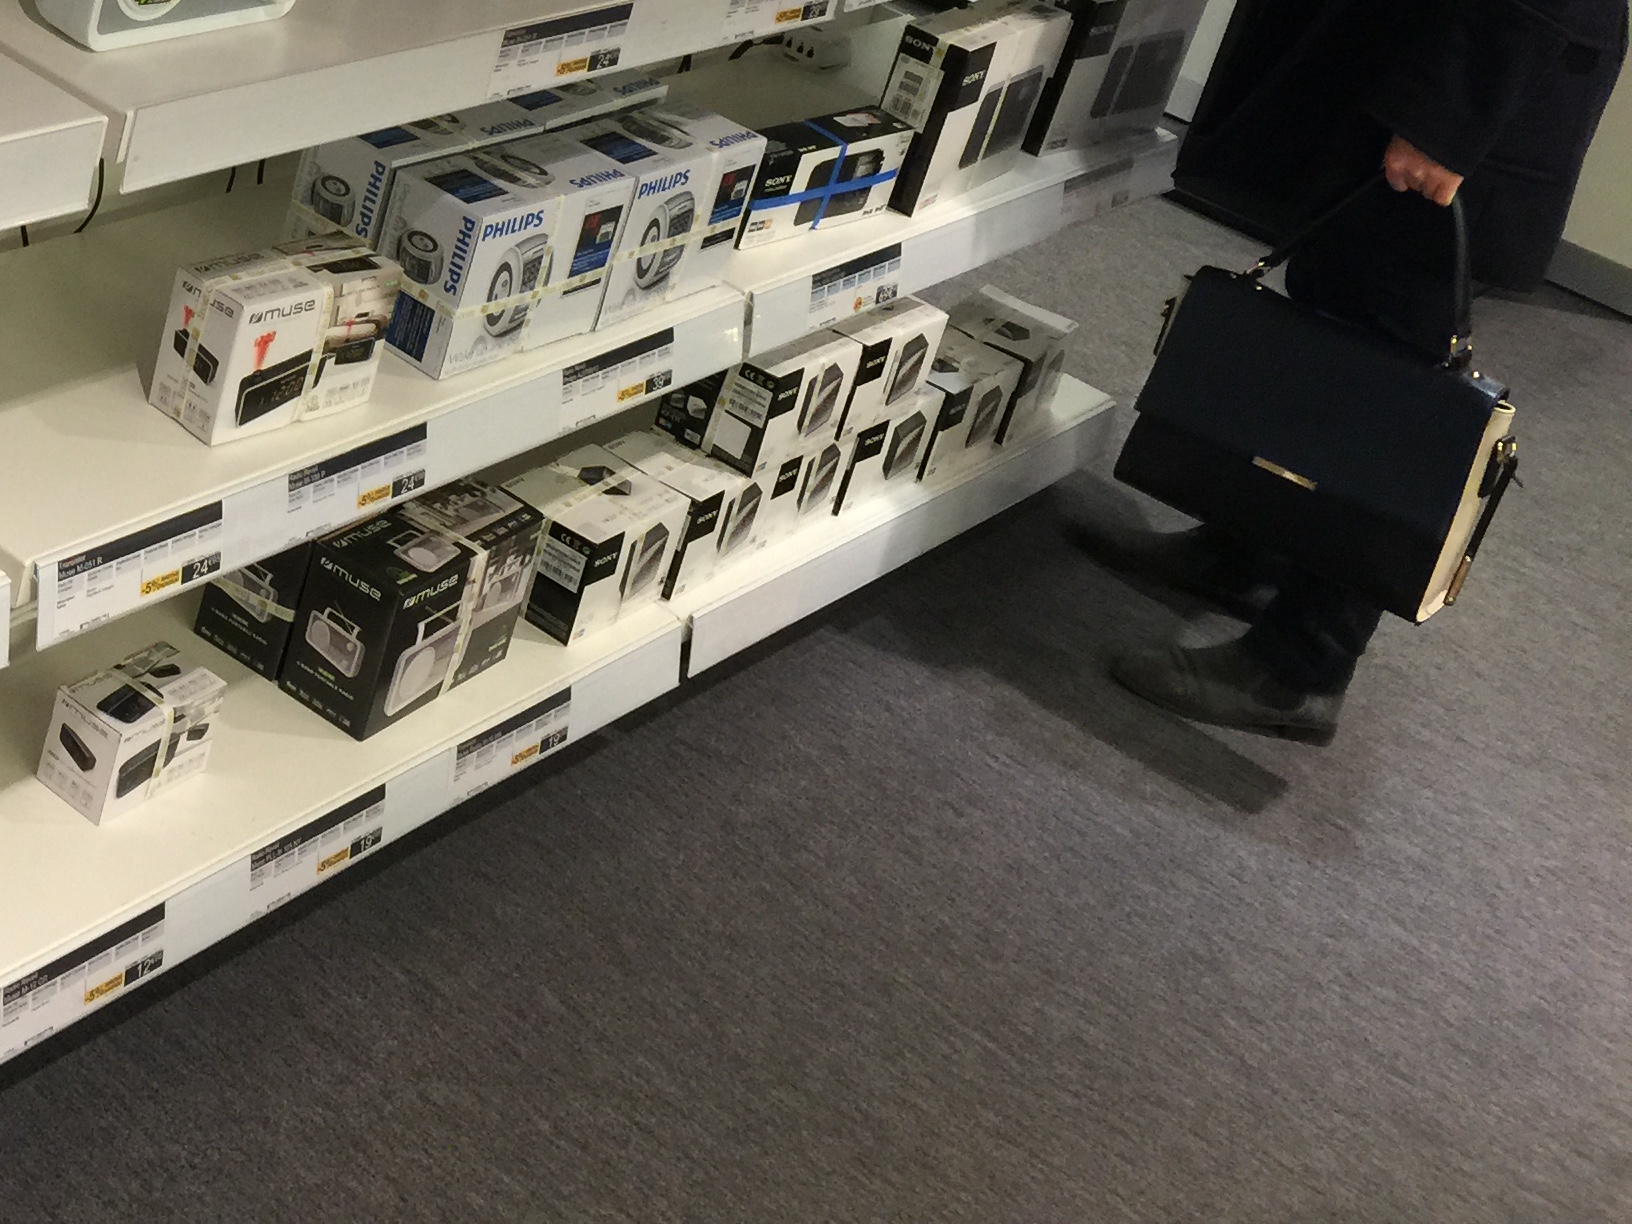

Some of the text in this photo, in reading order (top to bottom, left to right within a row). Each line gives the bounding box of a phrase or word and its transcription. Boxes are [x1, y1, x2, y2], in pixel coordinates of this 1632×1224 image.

[962, 70, 986, 86] SONY
[709, 131, 758, 149] PHILIPS
[568, 169, 625, 189] PHILIPS
[638, 169, 691, 200] PHILIPS
[764, 175, 792, 187] SONY
[355, 160, 386, 238] PHILIPS
[481, 210, 544, 242] PHILIPS
[443, 215, 476, 297] PHILIPS
[263, 299, 316, 321] muse
[867, 355, 886, 368] SONY
[778, 386, 799, 401] SONY
[865, 433, 884, 445] SONY
[779, 468, 799, 483] SONY
[697, 510, 718, 524] SONY
[594, 551, 618, 568] SONY
[141, 579, 158, 594] -5%
[331, 563, 382, 602] muse
[415, 574, 459, 605] muse
